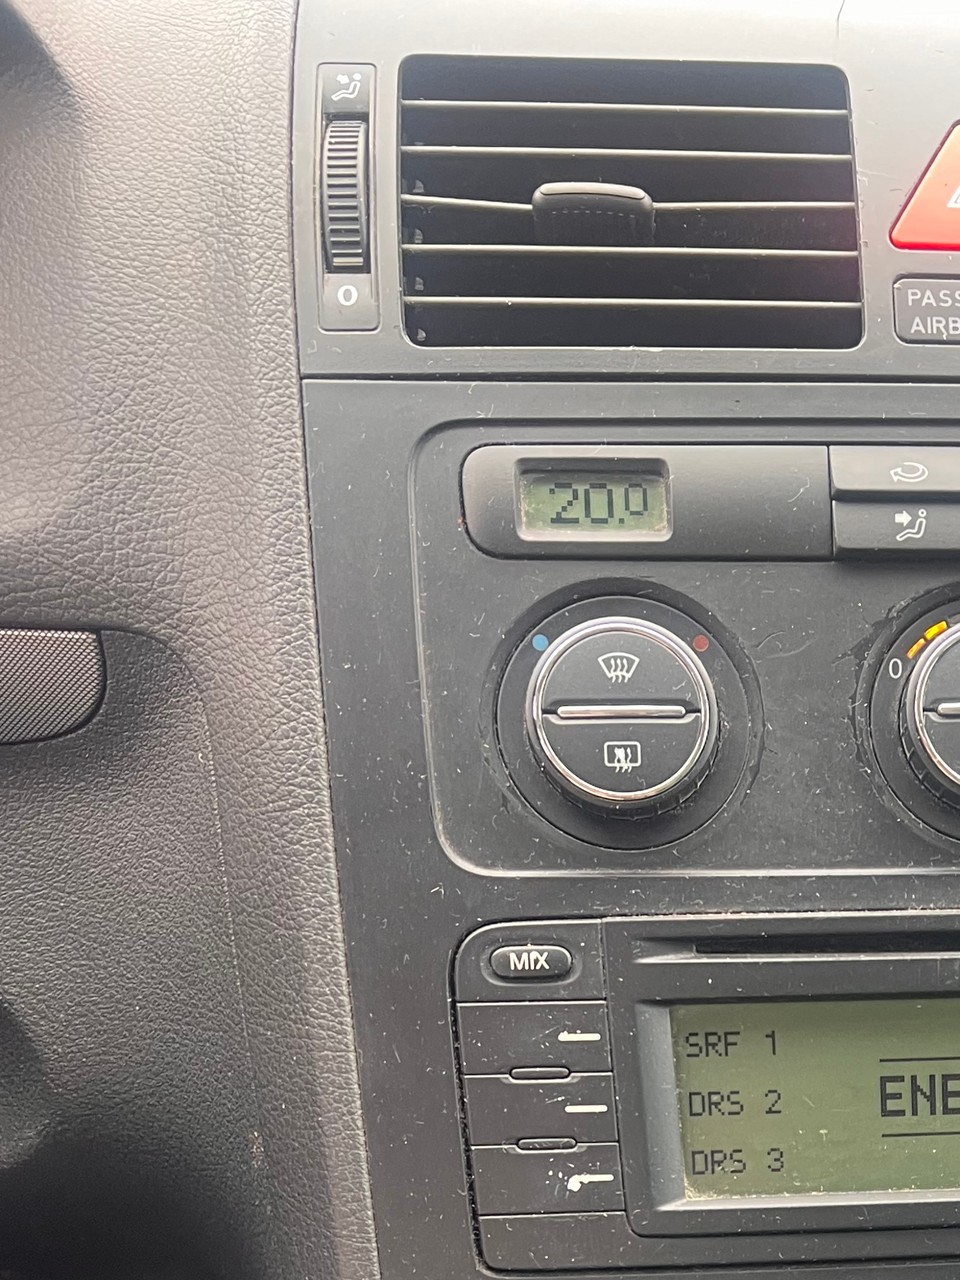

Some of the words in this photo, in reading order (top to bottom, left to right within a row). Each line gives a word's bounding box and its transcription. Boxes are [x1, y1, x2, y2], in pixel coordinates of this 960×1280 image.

[509, 950, 549, 971] MIX
[685, 1031, 741, 1058] SRF
[765, 1030, 777, 1056] 1
[688, 1090, 744, 1117] DRS
[765, 1089, 782, 1115] 2
[691, 1150, 746, 1176] DRS
[767, 1148, 785, 1173] 3
